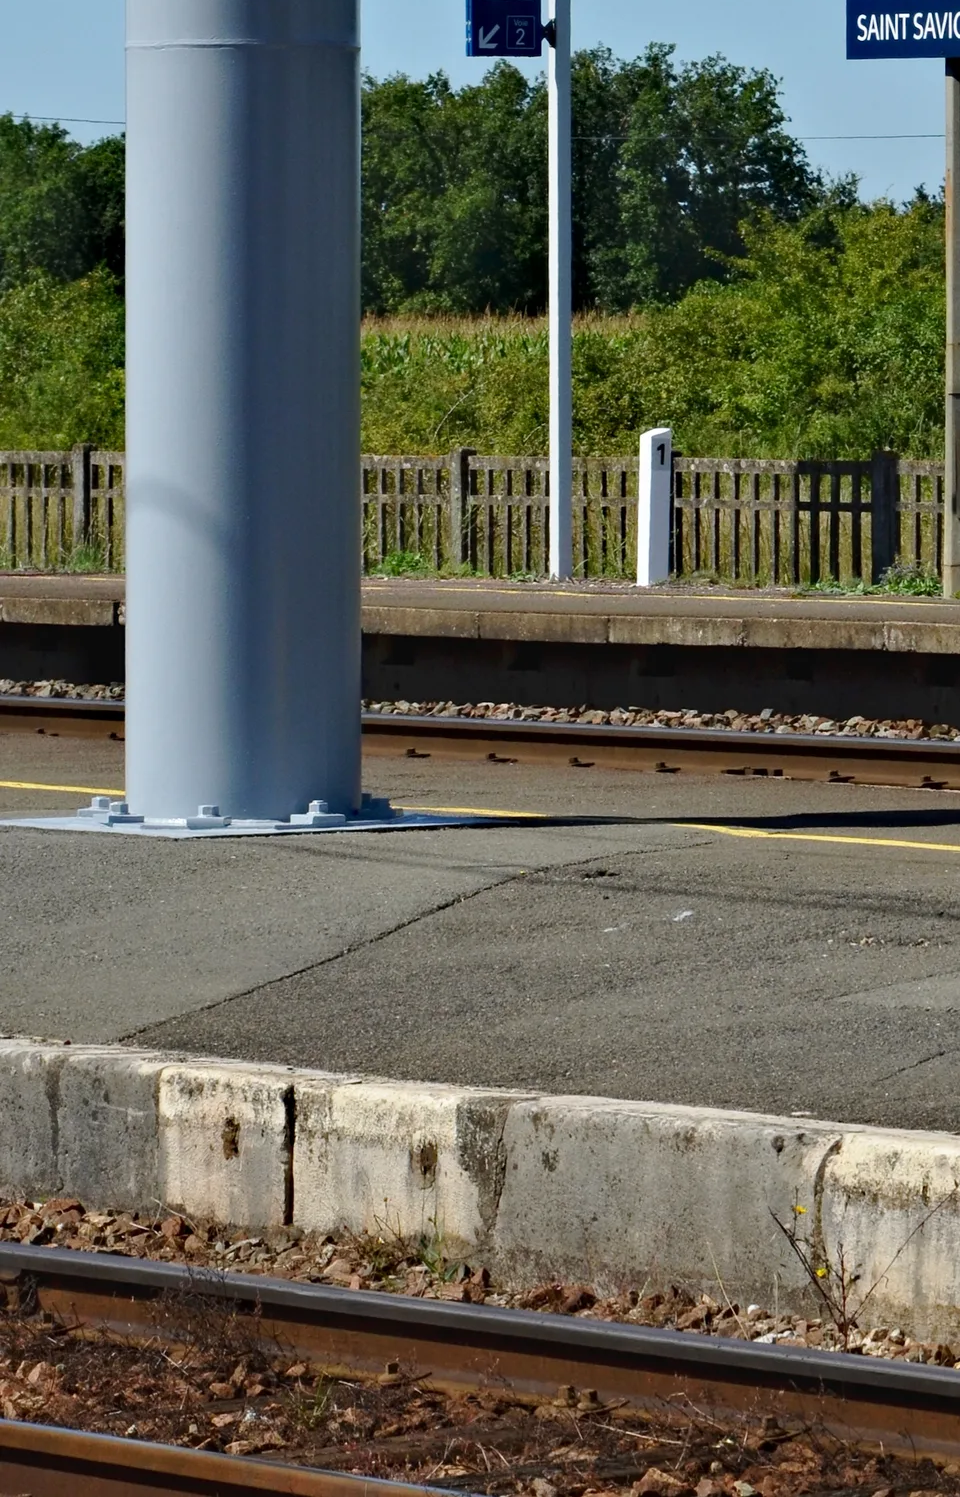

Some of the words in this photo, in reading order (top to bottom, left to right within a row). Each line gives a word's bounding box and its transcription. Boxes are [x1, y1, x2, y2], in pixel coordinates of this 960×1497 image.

[515, 28, 526, 46] 2
[857, 13, 910, 41] SAINT
[656, 443, 666, 466] 1
